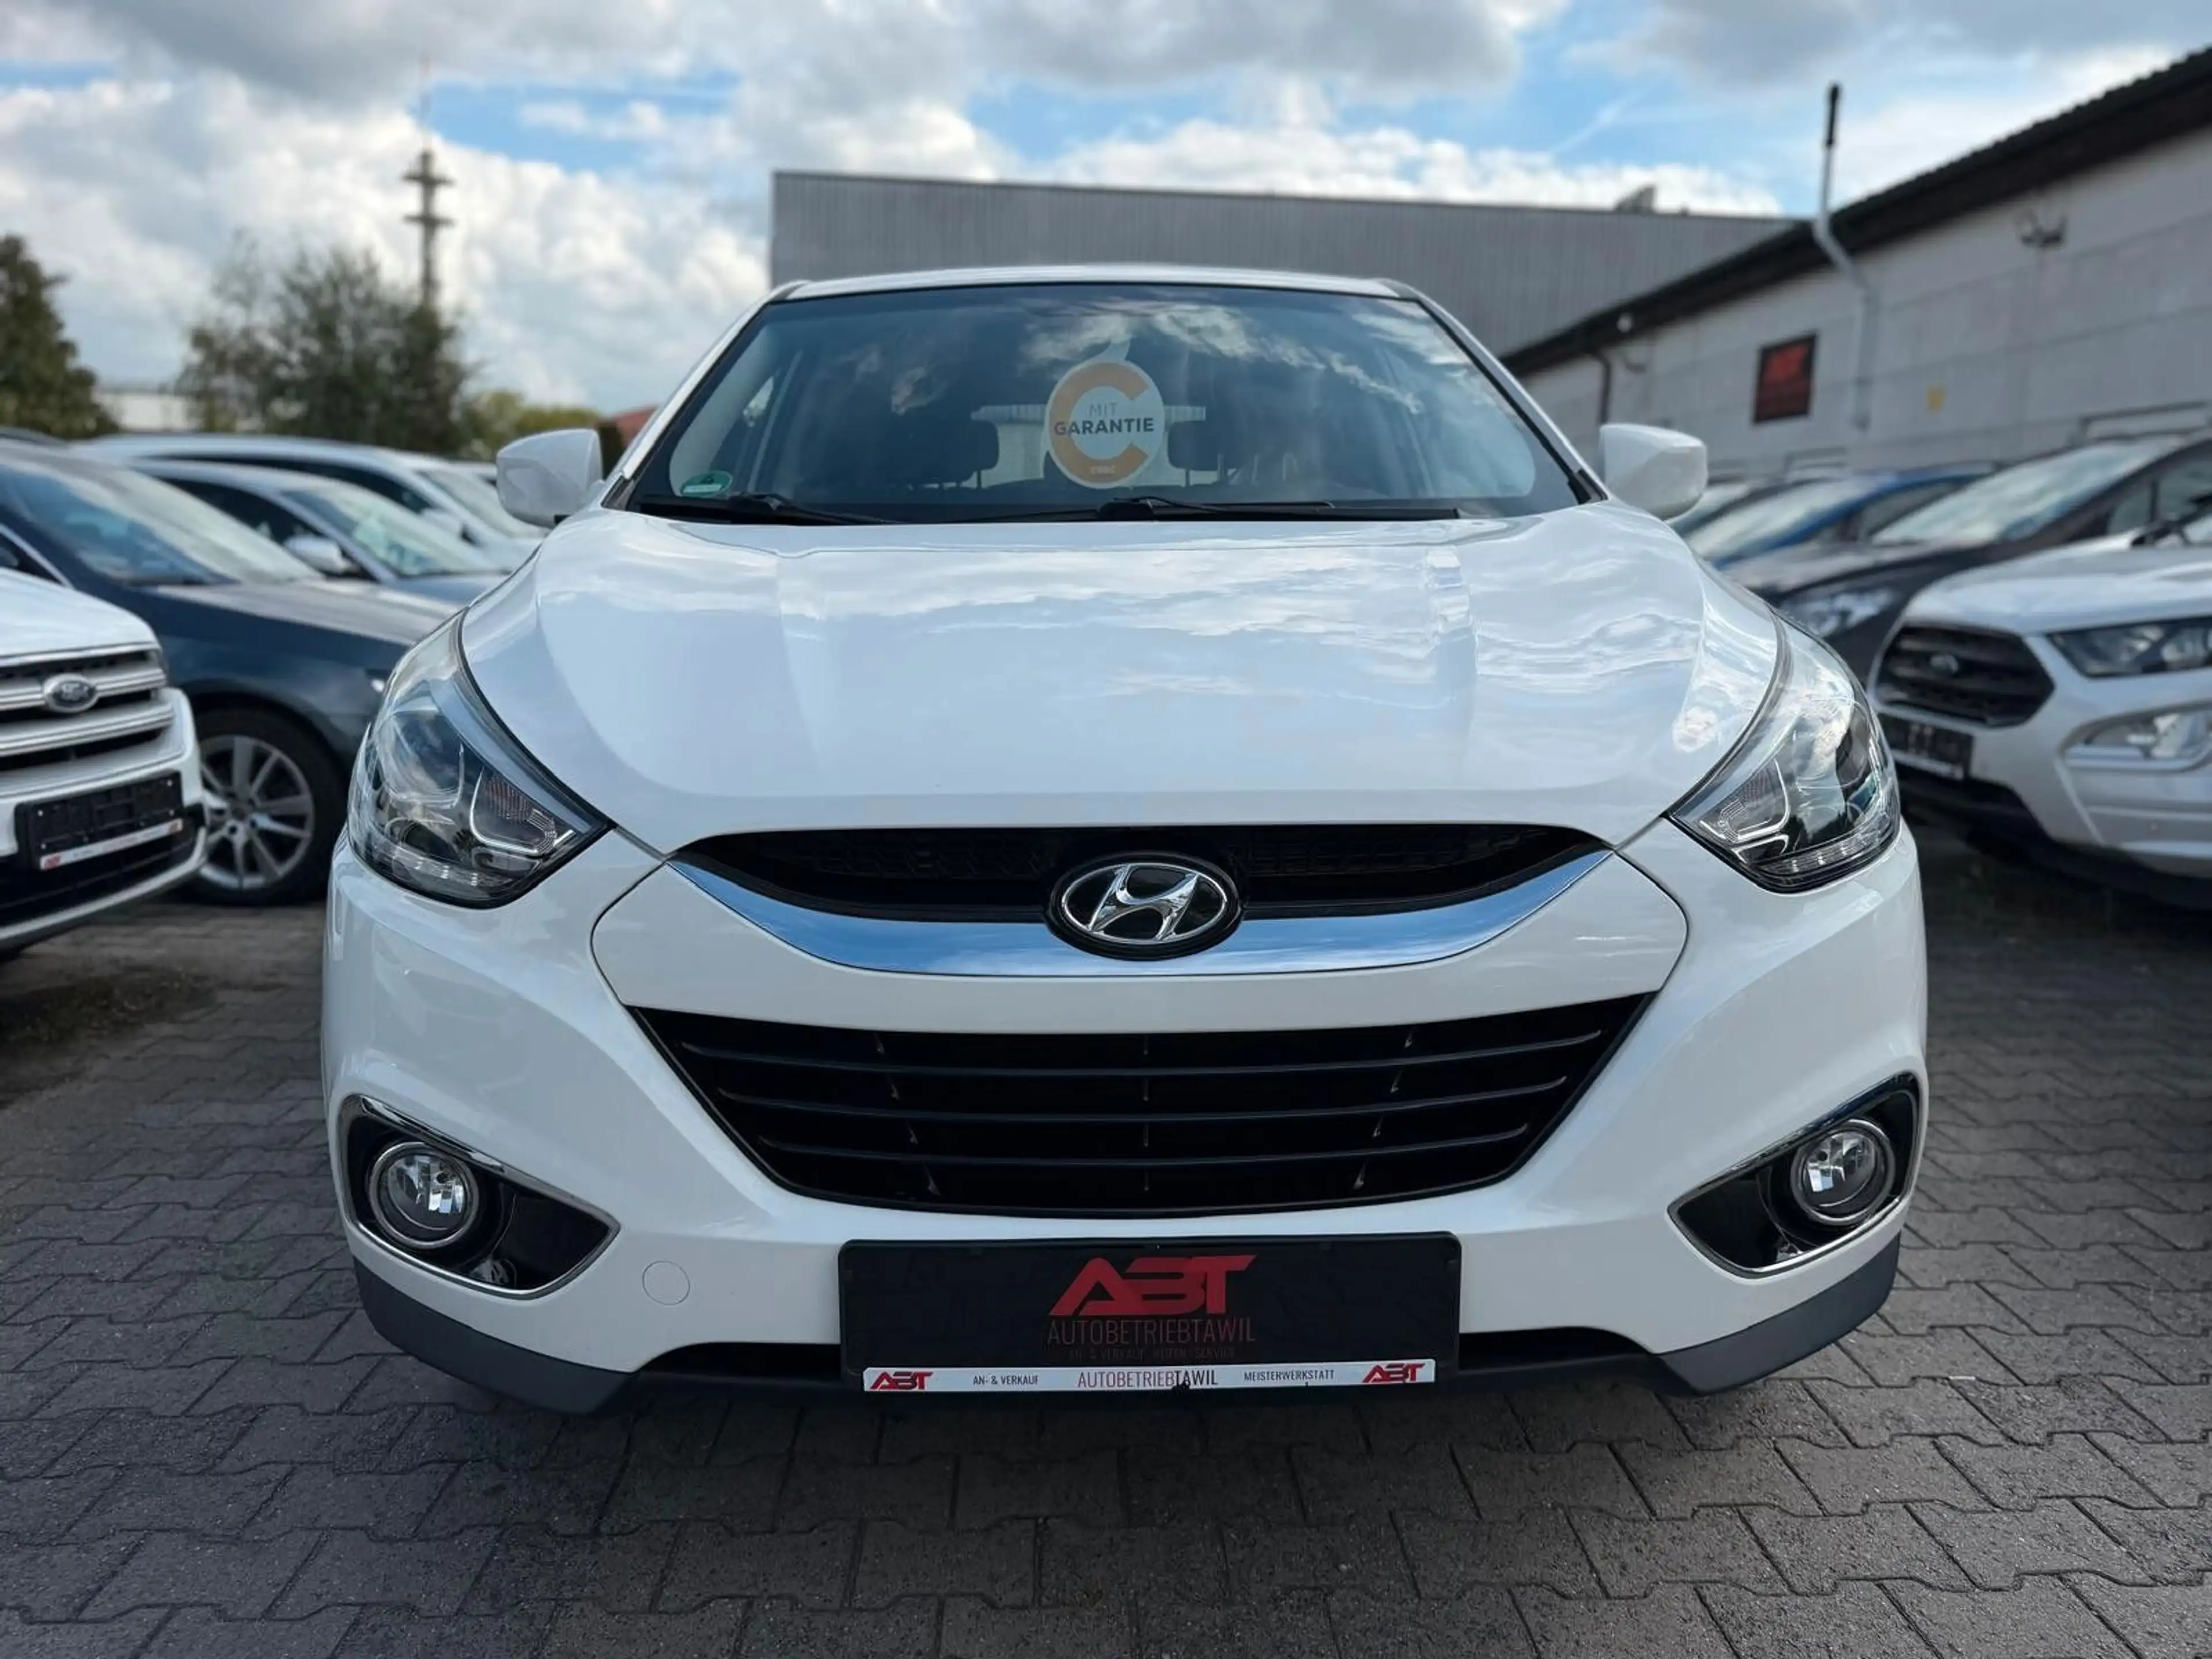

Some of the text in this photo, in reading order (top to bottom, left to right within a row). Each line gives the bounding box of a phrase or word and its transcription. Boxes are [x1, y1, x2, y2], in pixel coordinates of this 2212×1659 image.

[1089, 402, 1118, 417] MIT
[1054, 417, 1155, 436] GARANTIE
[1048, 1255, 1256, 1316] ABT
[1048, 1318, 1256, 1345] AUTOBETRIEBTAWIL
[870, 1363, 1426, 1390] ABT AN- & VERKAUF AUTOBETRIEBTAWIL MEISTERWERKSTATT ABT
